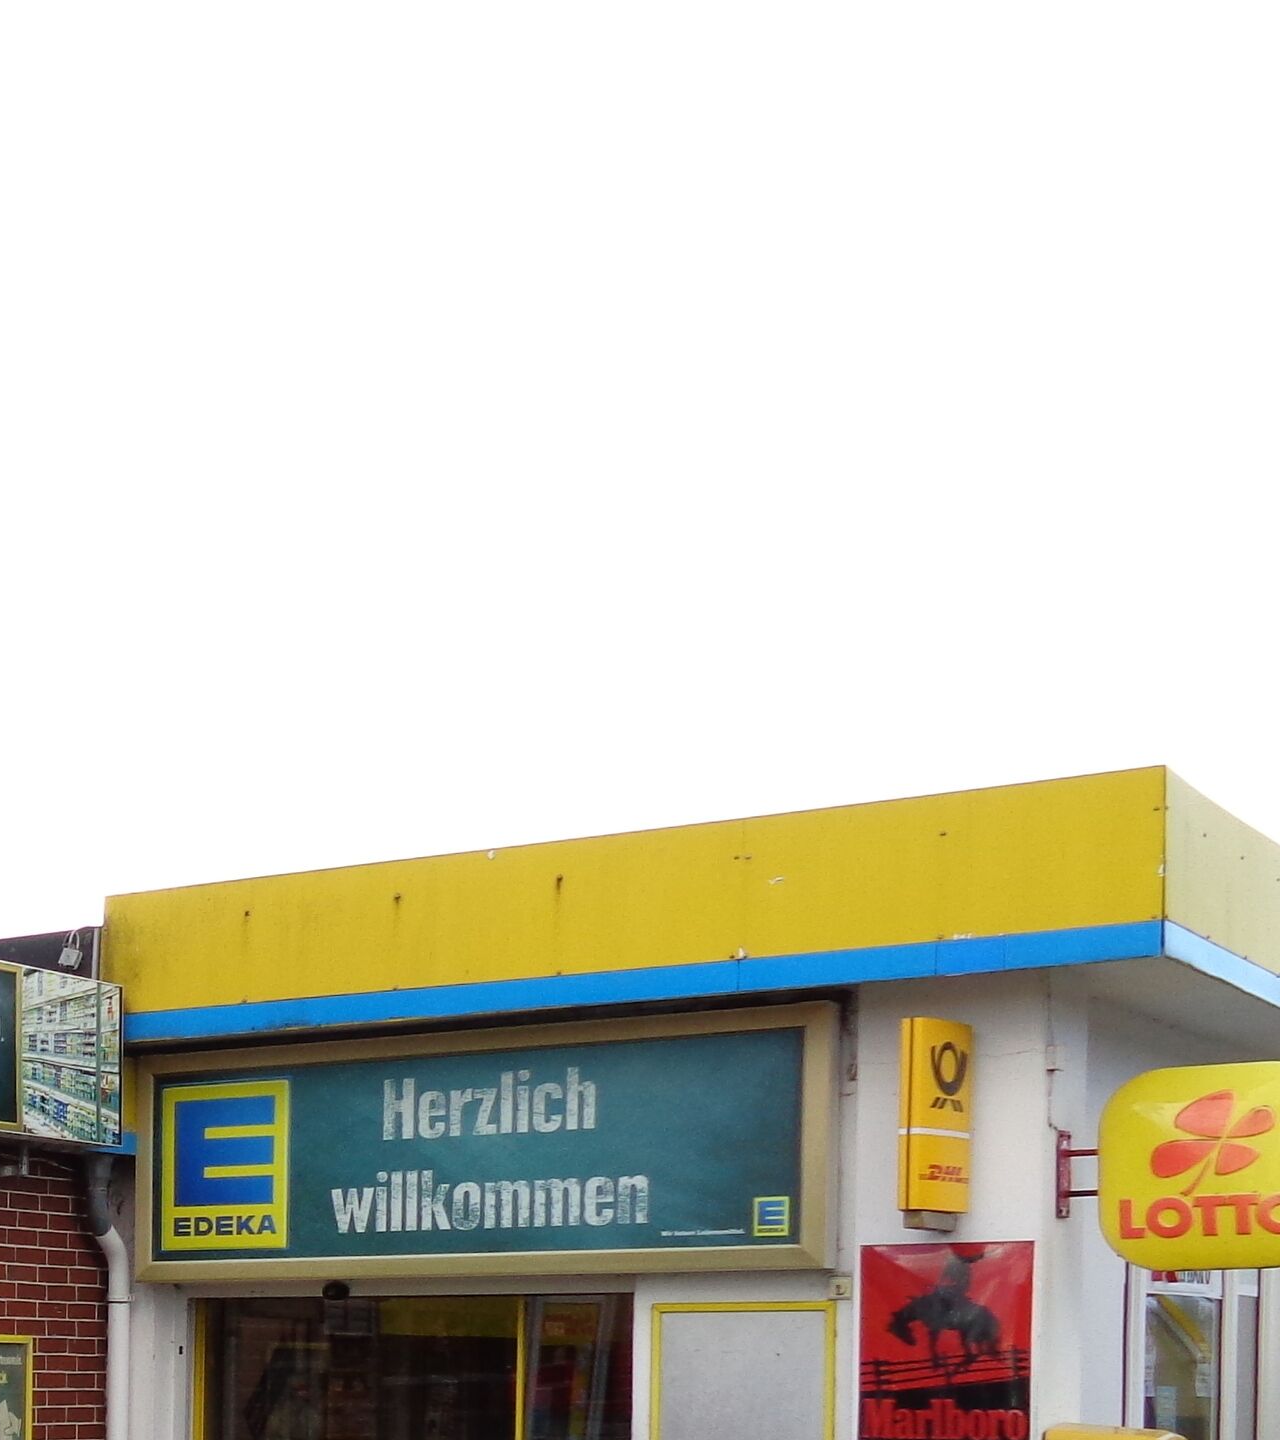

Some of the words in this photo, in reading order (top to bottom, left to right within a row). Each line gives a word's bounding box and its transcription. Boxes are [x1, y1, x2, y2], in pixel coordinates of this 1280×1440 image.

[381, 1066, 598, 1142] Herzlich
[173, 1214, 277, 1237] EDEKA
[330, 1168, 651, 1235] willkommen
[861, 1397, 1028, 1440] Marlboro
